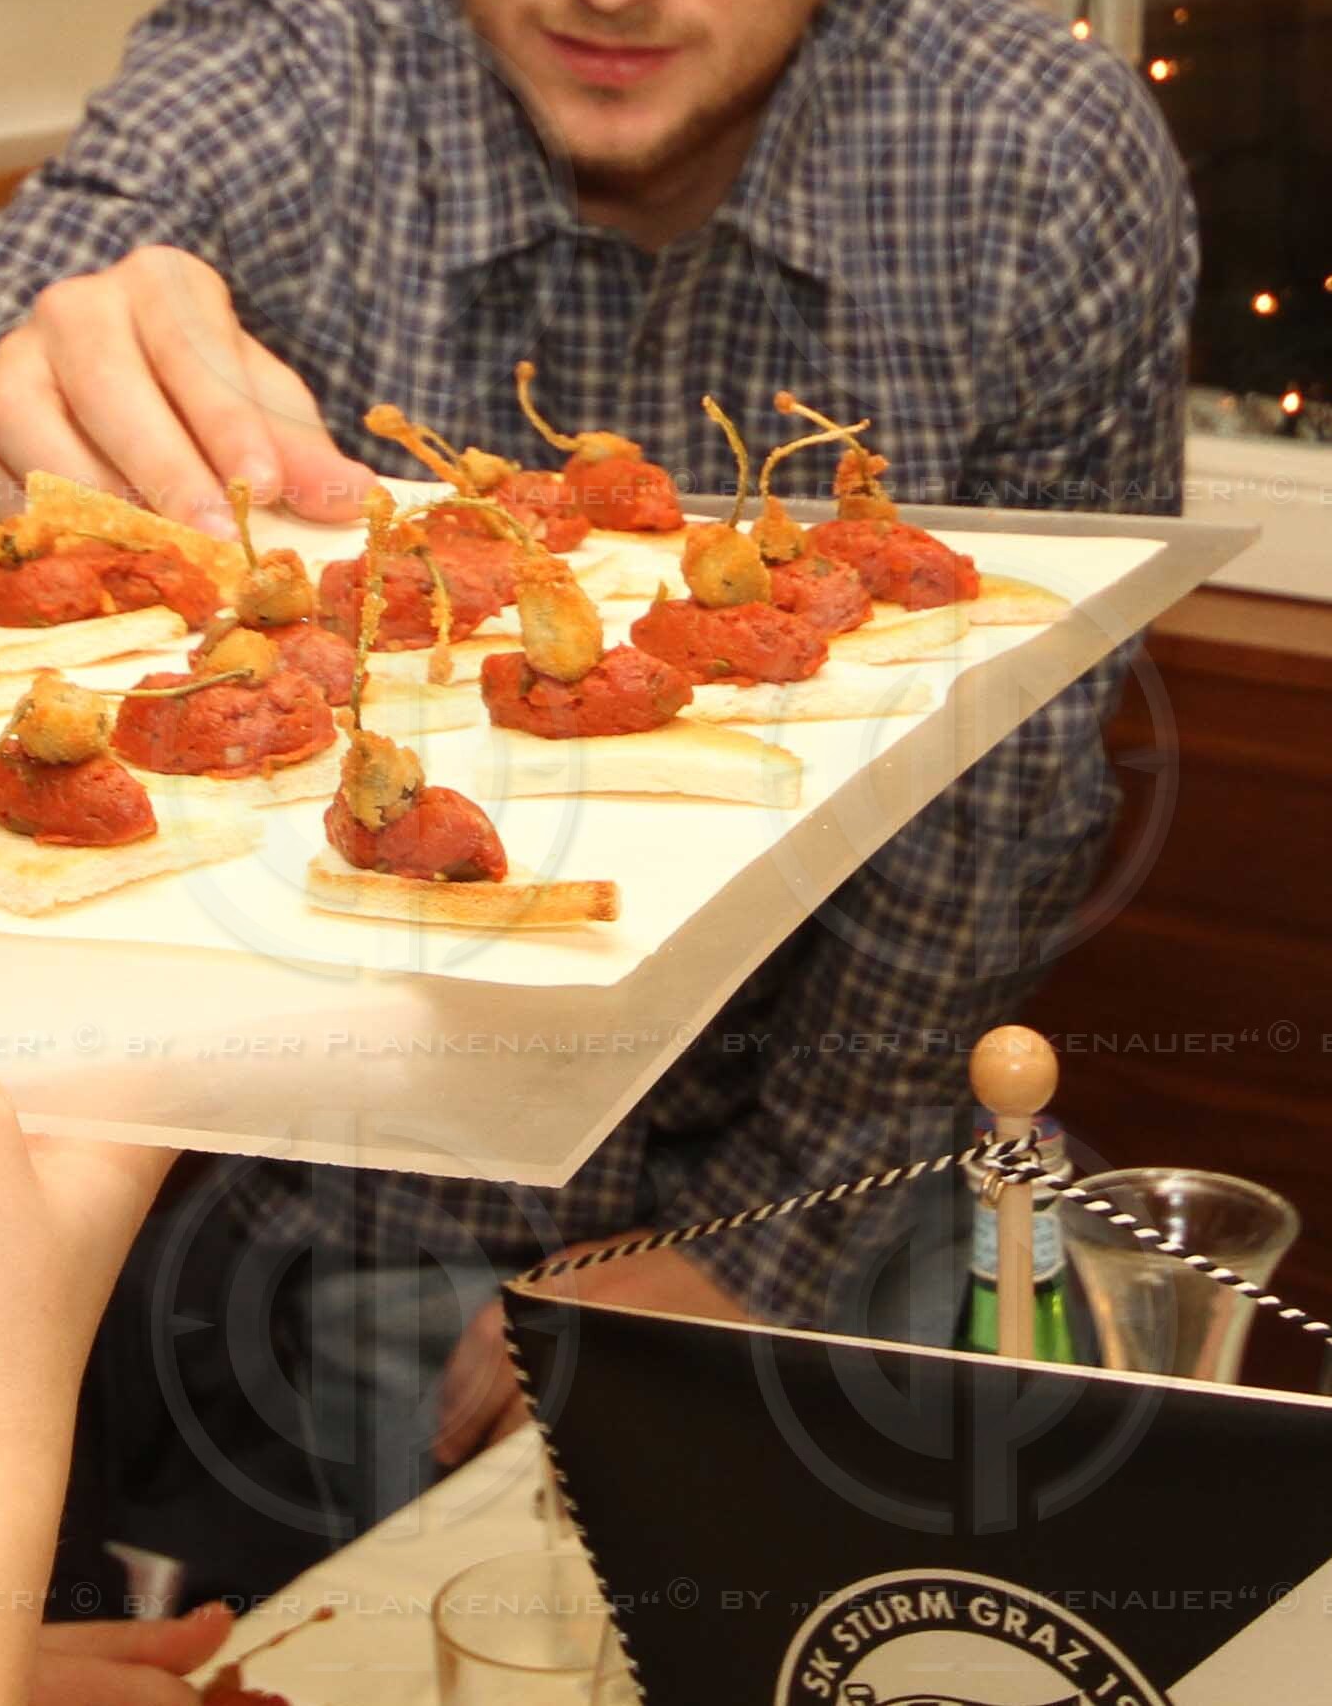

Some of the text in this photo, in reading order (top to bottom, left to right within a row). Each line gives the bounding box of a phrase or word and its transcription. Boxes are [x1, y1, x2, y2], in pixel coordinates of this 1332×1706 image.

[801, 1647, 843, 1699] SK
[831, 1590, 955, 1653] STURM
[968, 1596, 1091, 1673] GRAZ
